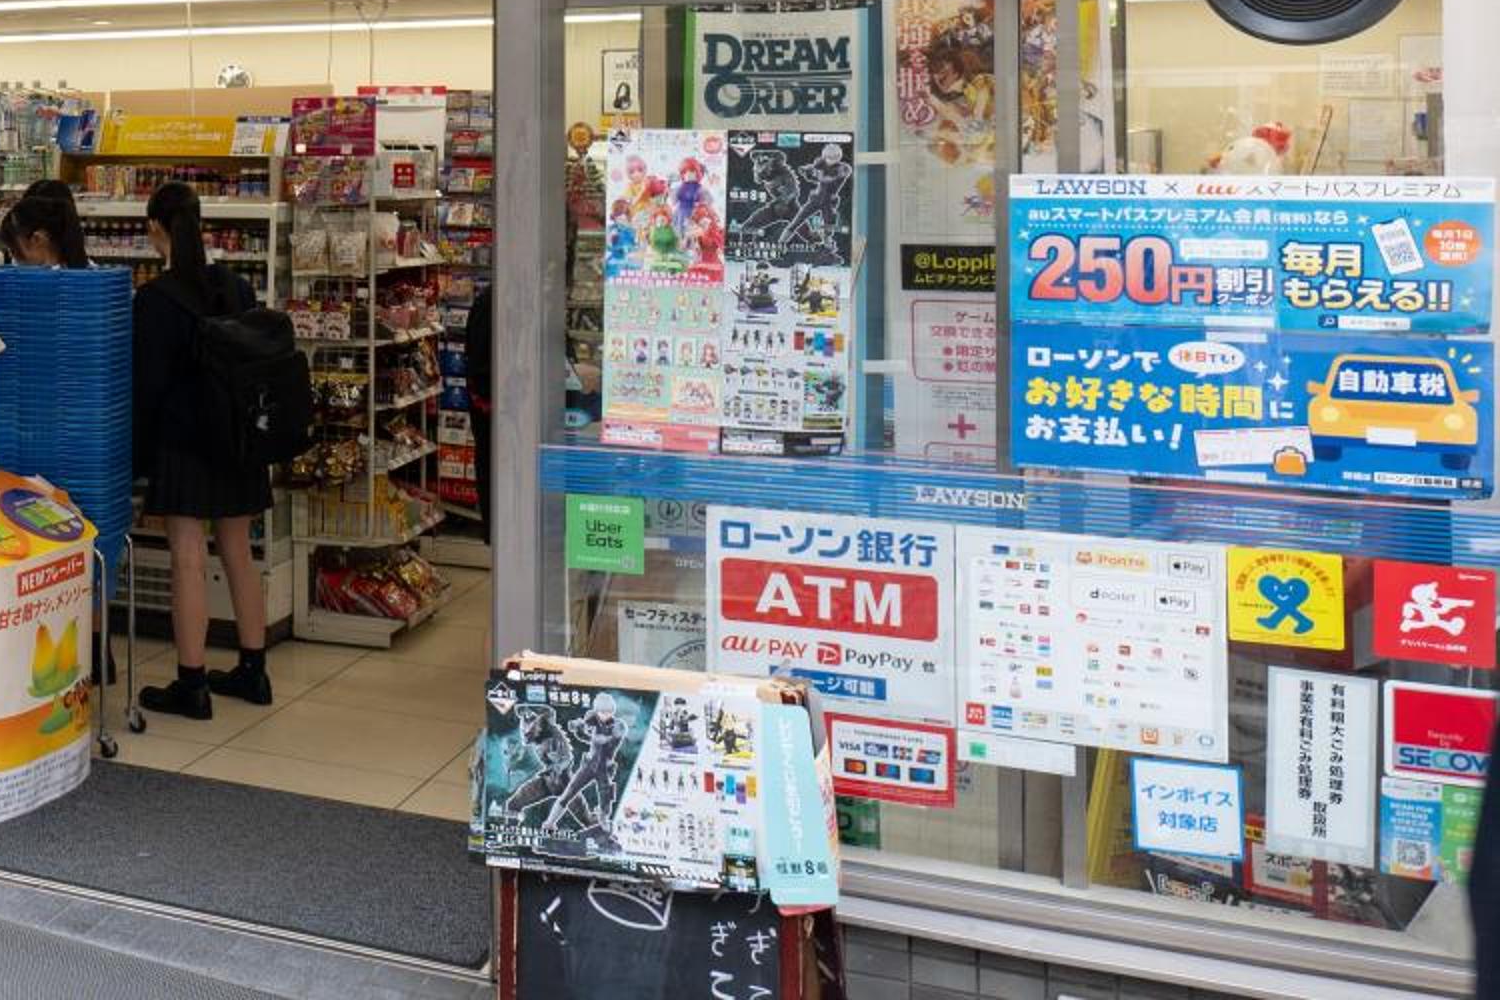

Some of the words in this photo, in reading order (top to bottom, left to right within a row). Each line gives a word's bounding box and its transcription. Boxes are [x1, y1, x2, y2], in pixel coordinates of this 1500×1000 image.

[702, 33, 851, 75] DREAM
[703, 75, 849, 119] ORDER
[1035, 179, 1147, 196] LAWSON
[1246, 180, 1462, 199] スマートパスプレミアム
[1282, 241, 1363, 277] 毎月
[1216, 267, 1274, 294] 割引
[1283, 278, 1451, 313] もらえる!!
[1026, 346, 1162, 374] ローソンで
[1338, 368, 1447, 398] 自動車税
[1025, 375, 1295, 421] お好きな時間に
[1025, 413, 1184, 451] お支払い!
[915, 485, 1029, 512] LAWSON
[585, 519, 623, 535] Uber
[585, 534, 624, 550] Eats
[720, 519, 938, 568] ローソン銀行
[755, 571, 902, 627] ATM
[721, 635, 766, 654] au
[768, 639, 808, 659] PAY
[845, 648, 914, 672] PayPay
[812, 677, 876, 698] ージ可能
[1141, 783, 1234, 808] インボイス
[1158, 810, 1220, 833] 対象店
